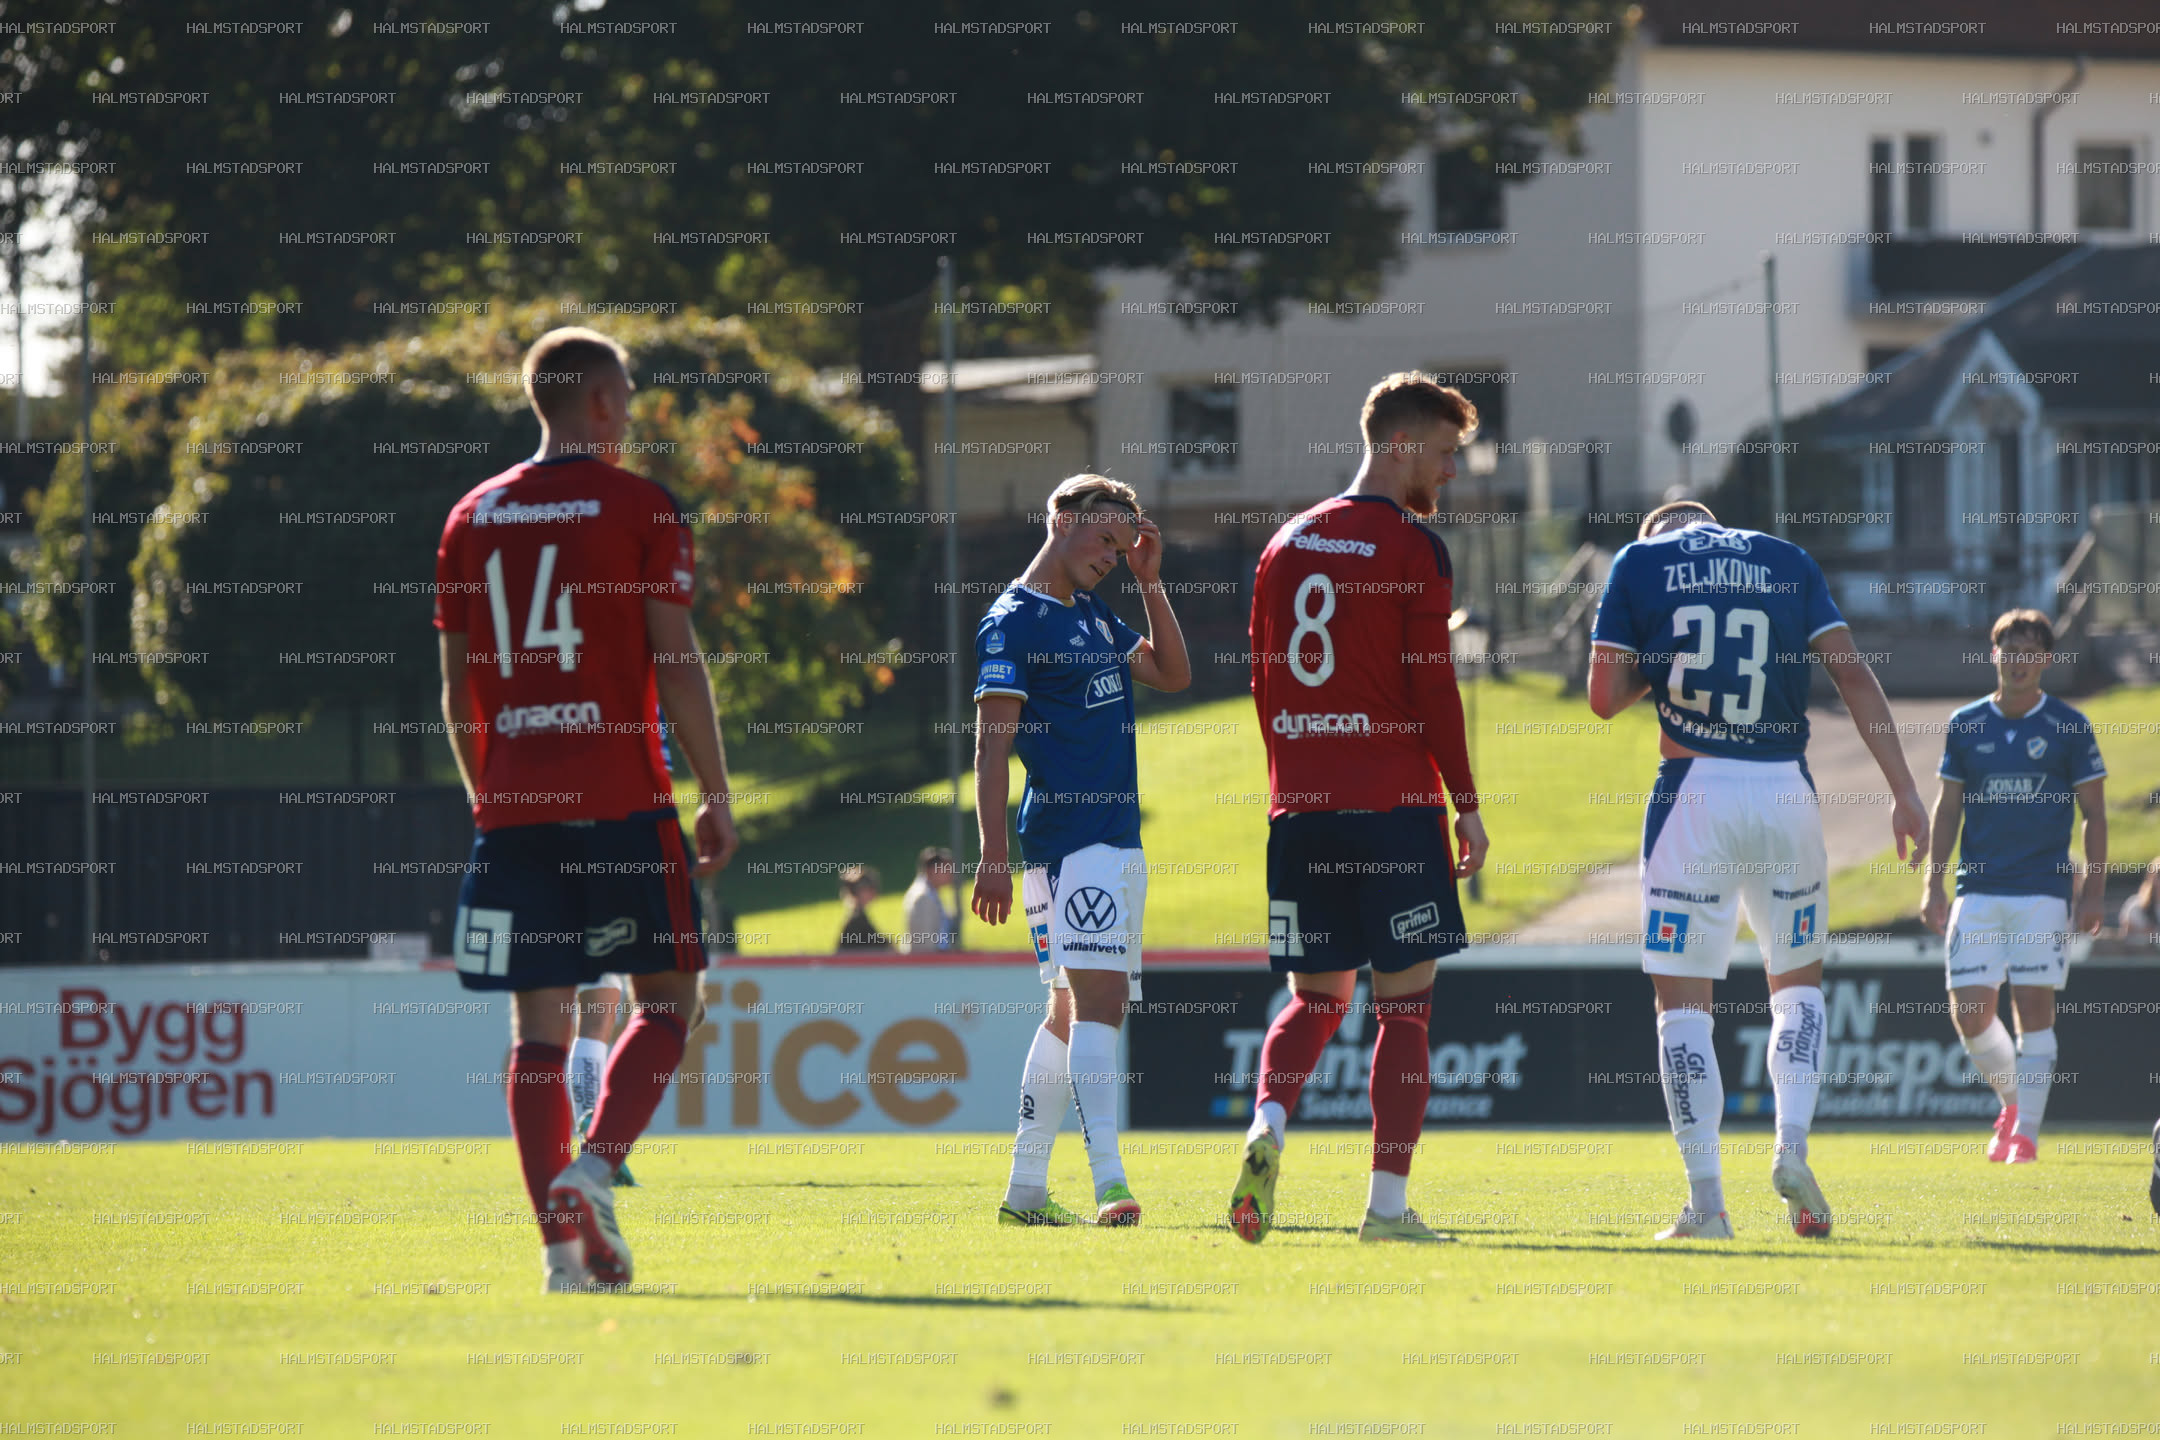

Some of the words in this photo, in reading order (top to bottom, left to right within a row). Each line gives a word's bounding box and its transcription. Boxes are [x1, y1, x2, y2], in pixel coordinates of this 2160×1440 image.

[1285, 527, 1376, 558] Fellessons
[1689, 536, 1746, 551] EAB
[1663, 558, 1772, 593] ZELJKOVIC
[485, 544, 584, 678] 14
[1288, 573, 1336, 687] 8
[1667, 604, 1770, 724] 23
[1272, 709, 1370, 740] dynacon
[1063, 941, 1117, 954] villalivet
[58, 986, 249, 1066] Bygg
[1777, 1029, 1795, 1052] GN
[1789, 1001, 1817, 1064] Transport
[0, 1056, 277, 1137] Sjögren
[1023, 1094, 1035, 1121] GN
